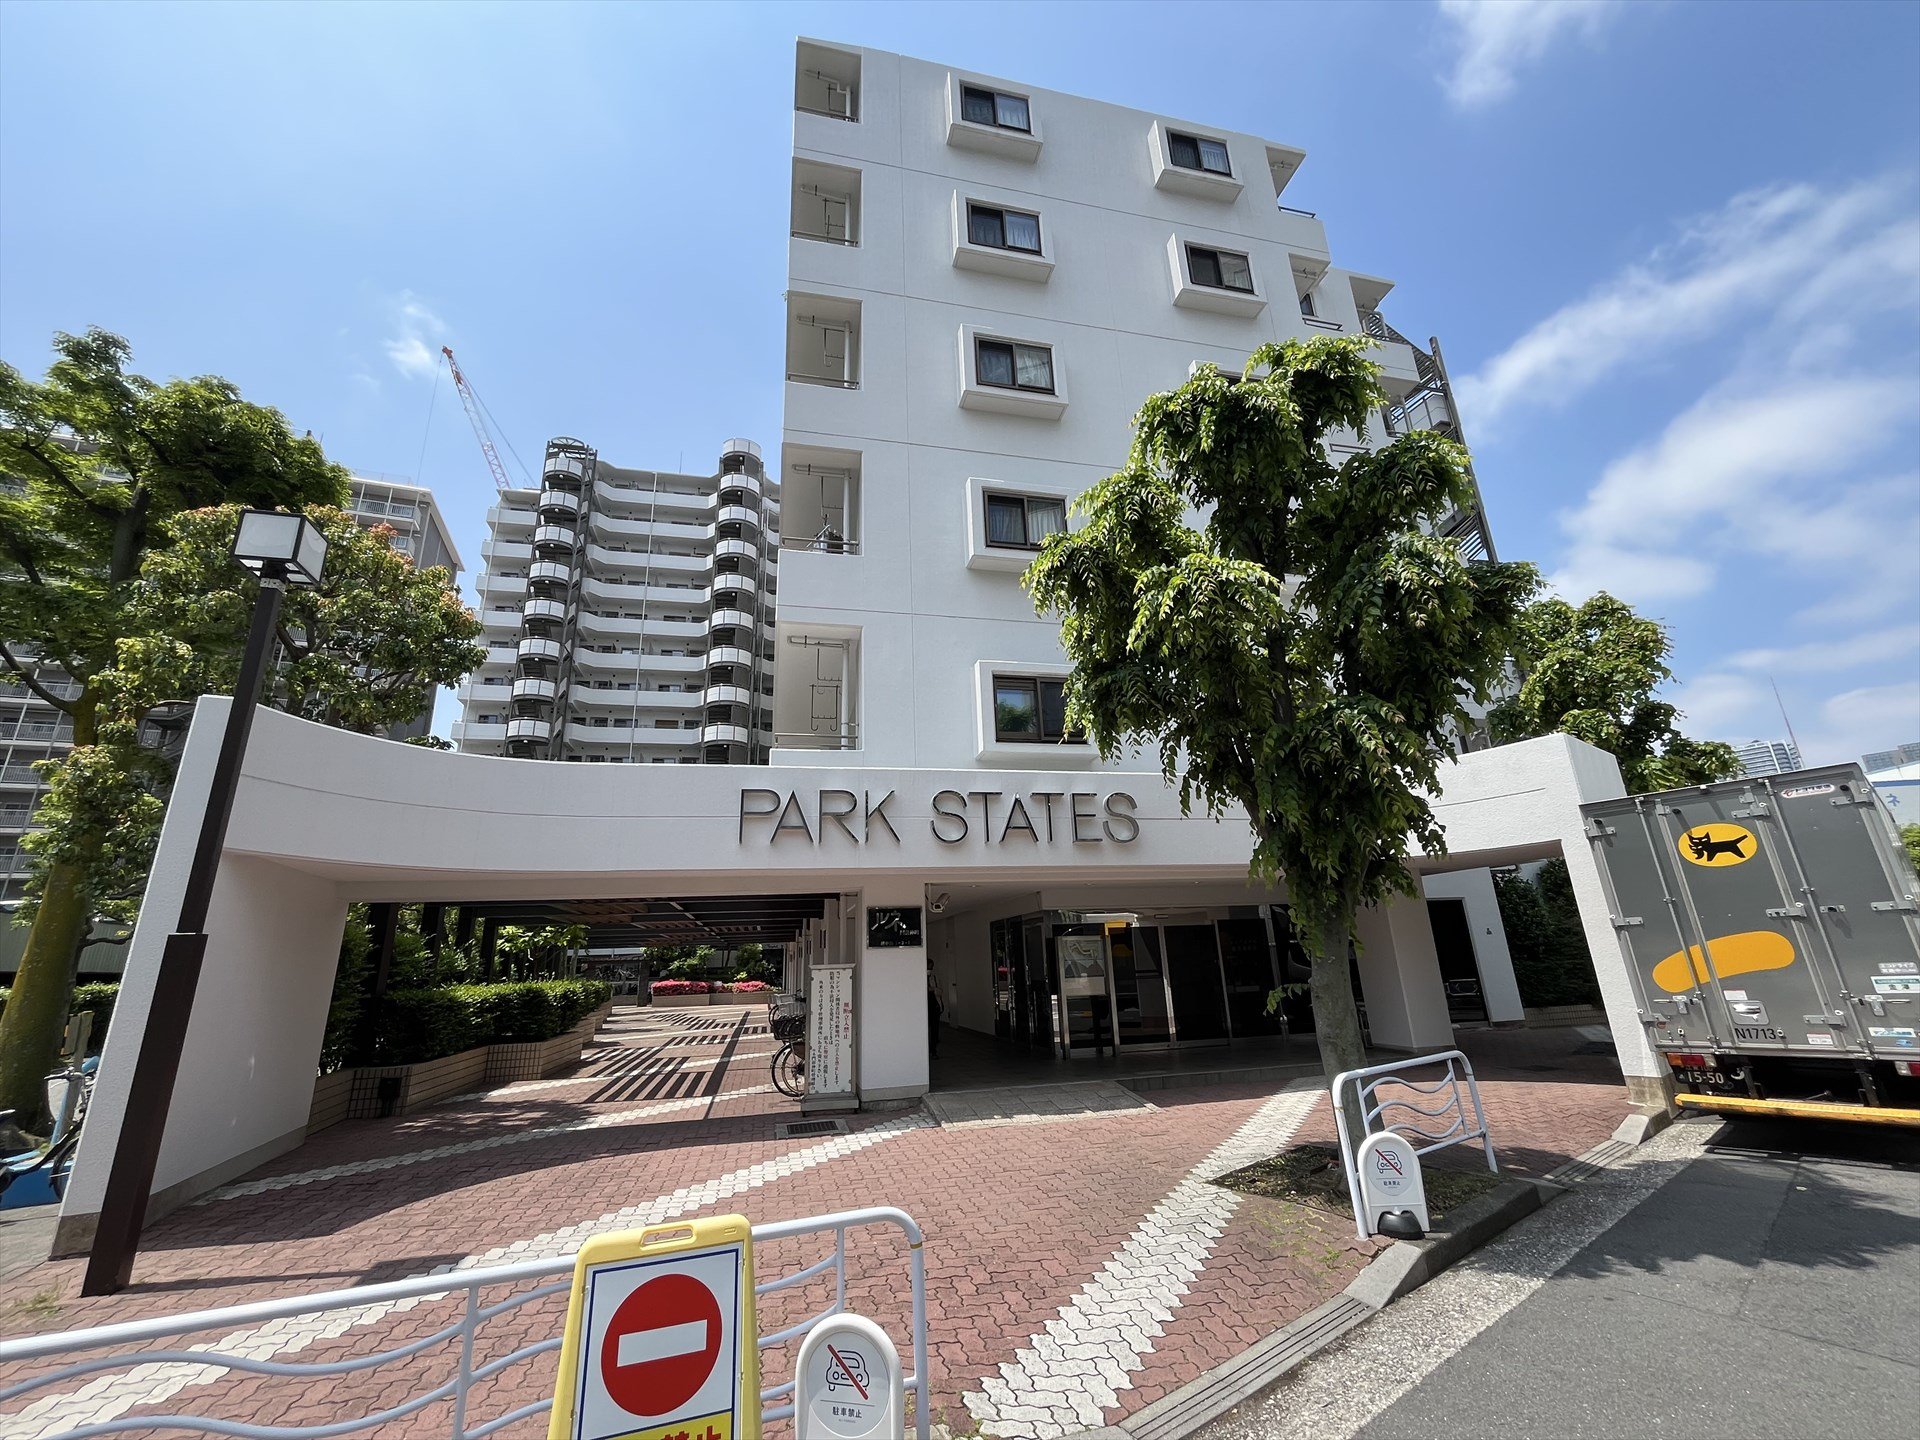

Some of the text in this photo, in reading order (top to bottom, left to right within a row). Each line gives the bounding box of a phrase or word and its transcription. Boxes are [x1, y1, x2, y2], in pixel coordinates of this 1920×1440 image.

[738, 788, 1141, 845] PARK STATES
[1734, 1028, 1777, 1039] N1713
[1687, 1071, 1725, 1084] 15-50
[832, 1406, 862, 1418] 駐車禁止
